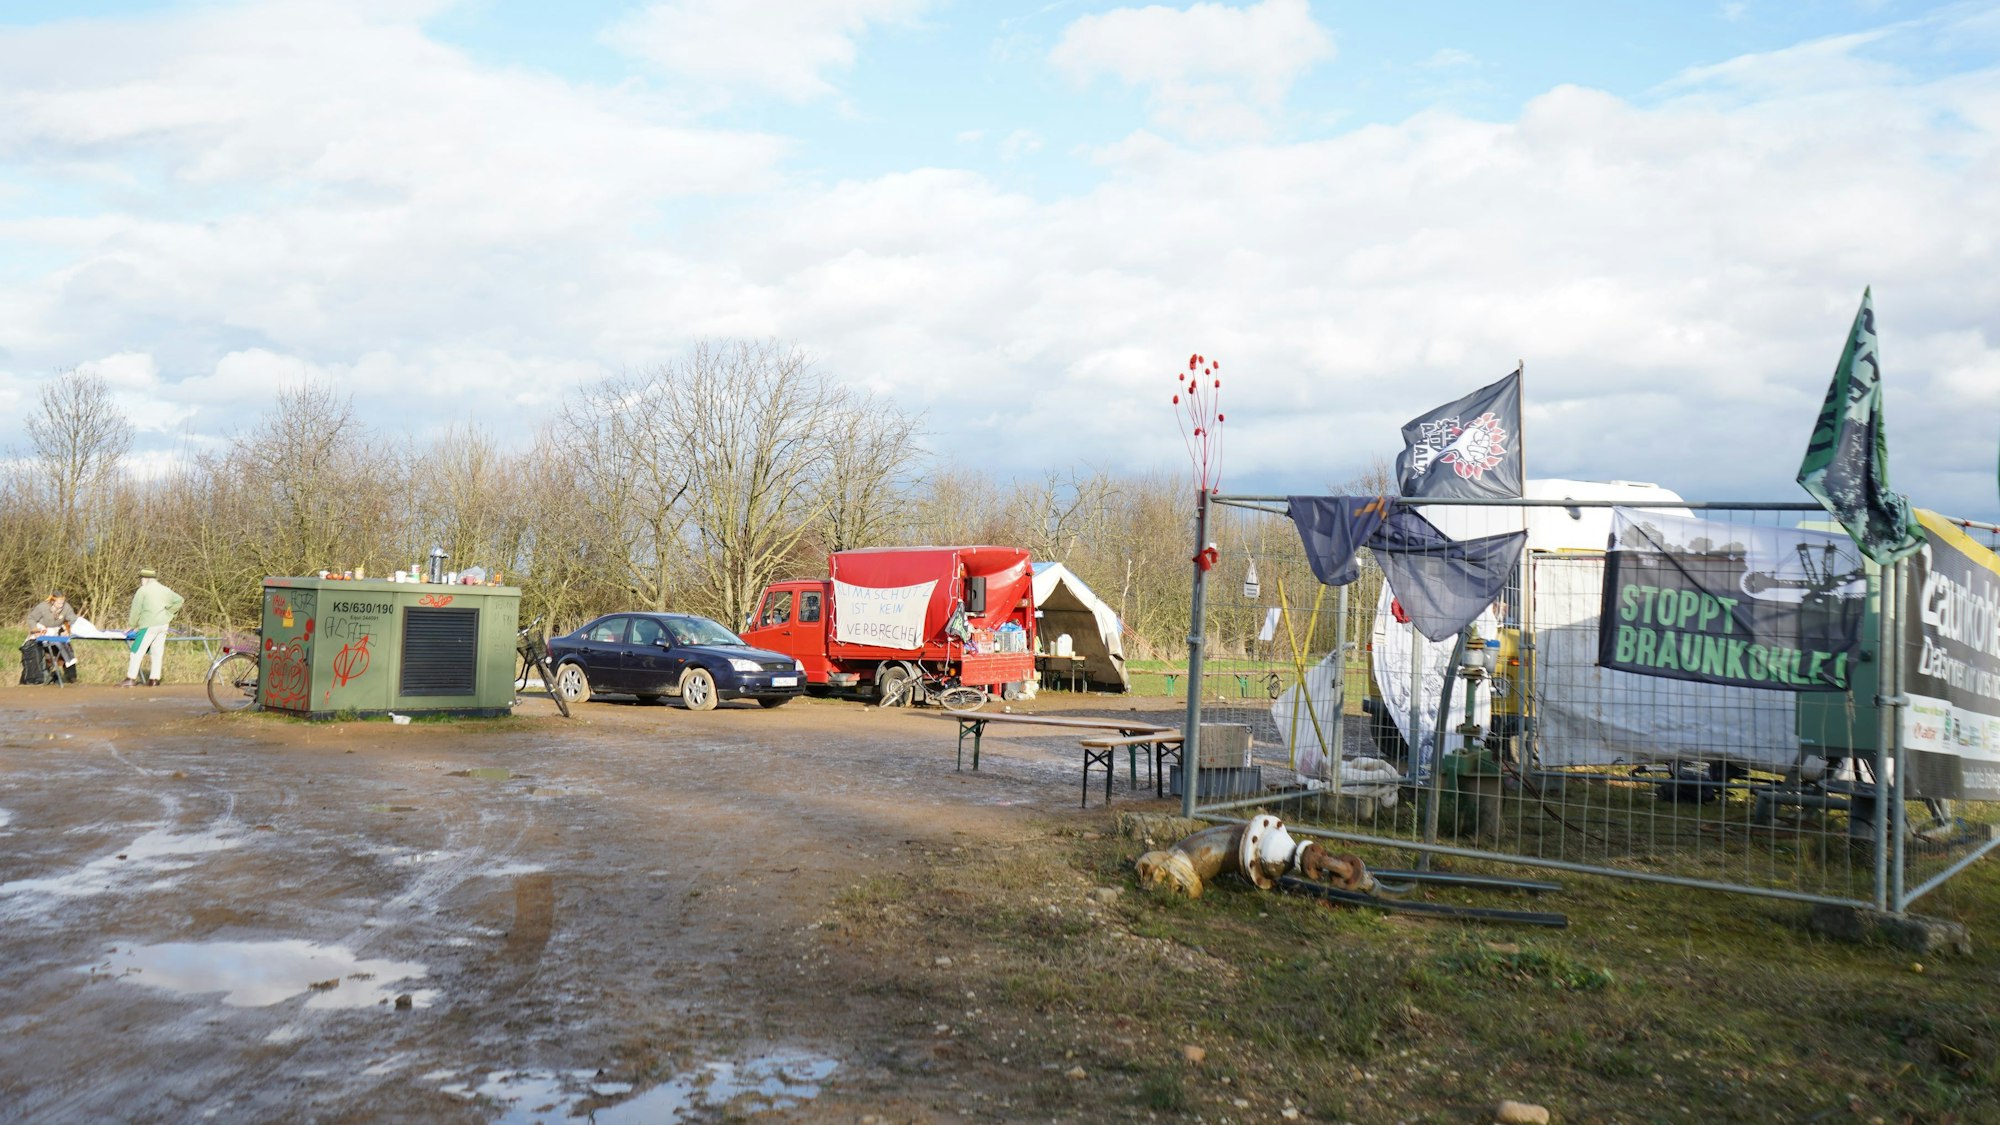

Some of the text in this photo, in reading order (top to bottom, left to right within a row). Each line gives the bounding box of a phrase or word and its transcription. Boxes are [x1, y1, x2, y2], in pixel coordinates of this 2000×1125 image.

[851, 602, 904, 615] IST KEIN
[1620, 584, 1738, 634] STOPPT
